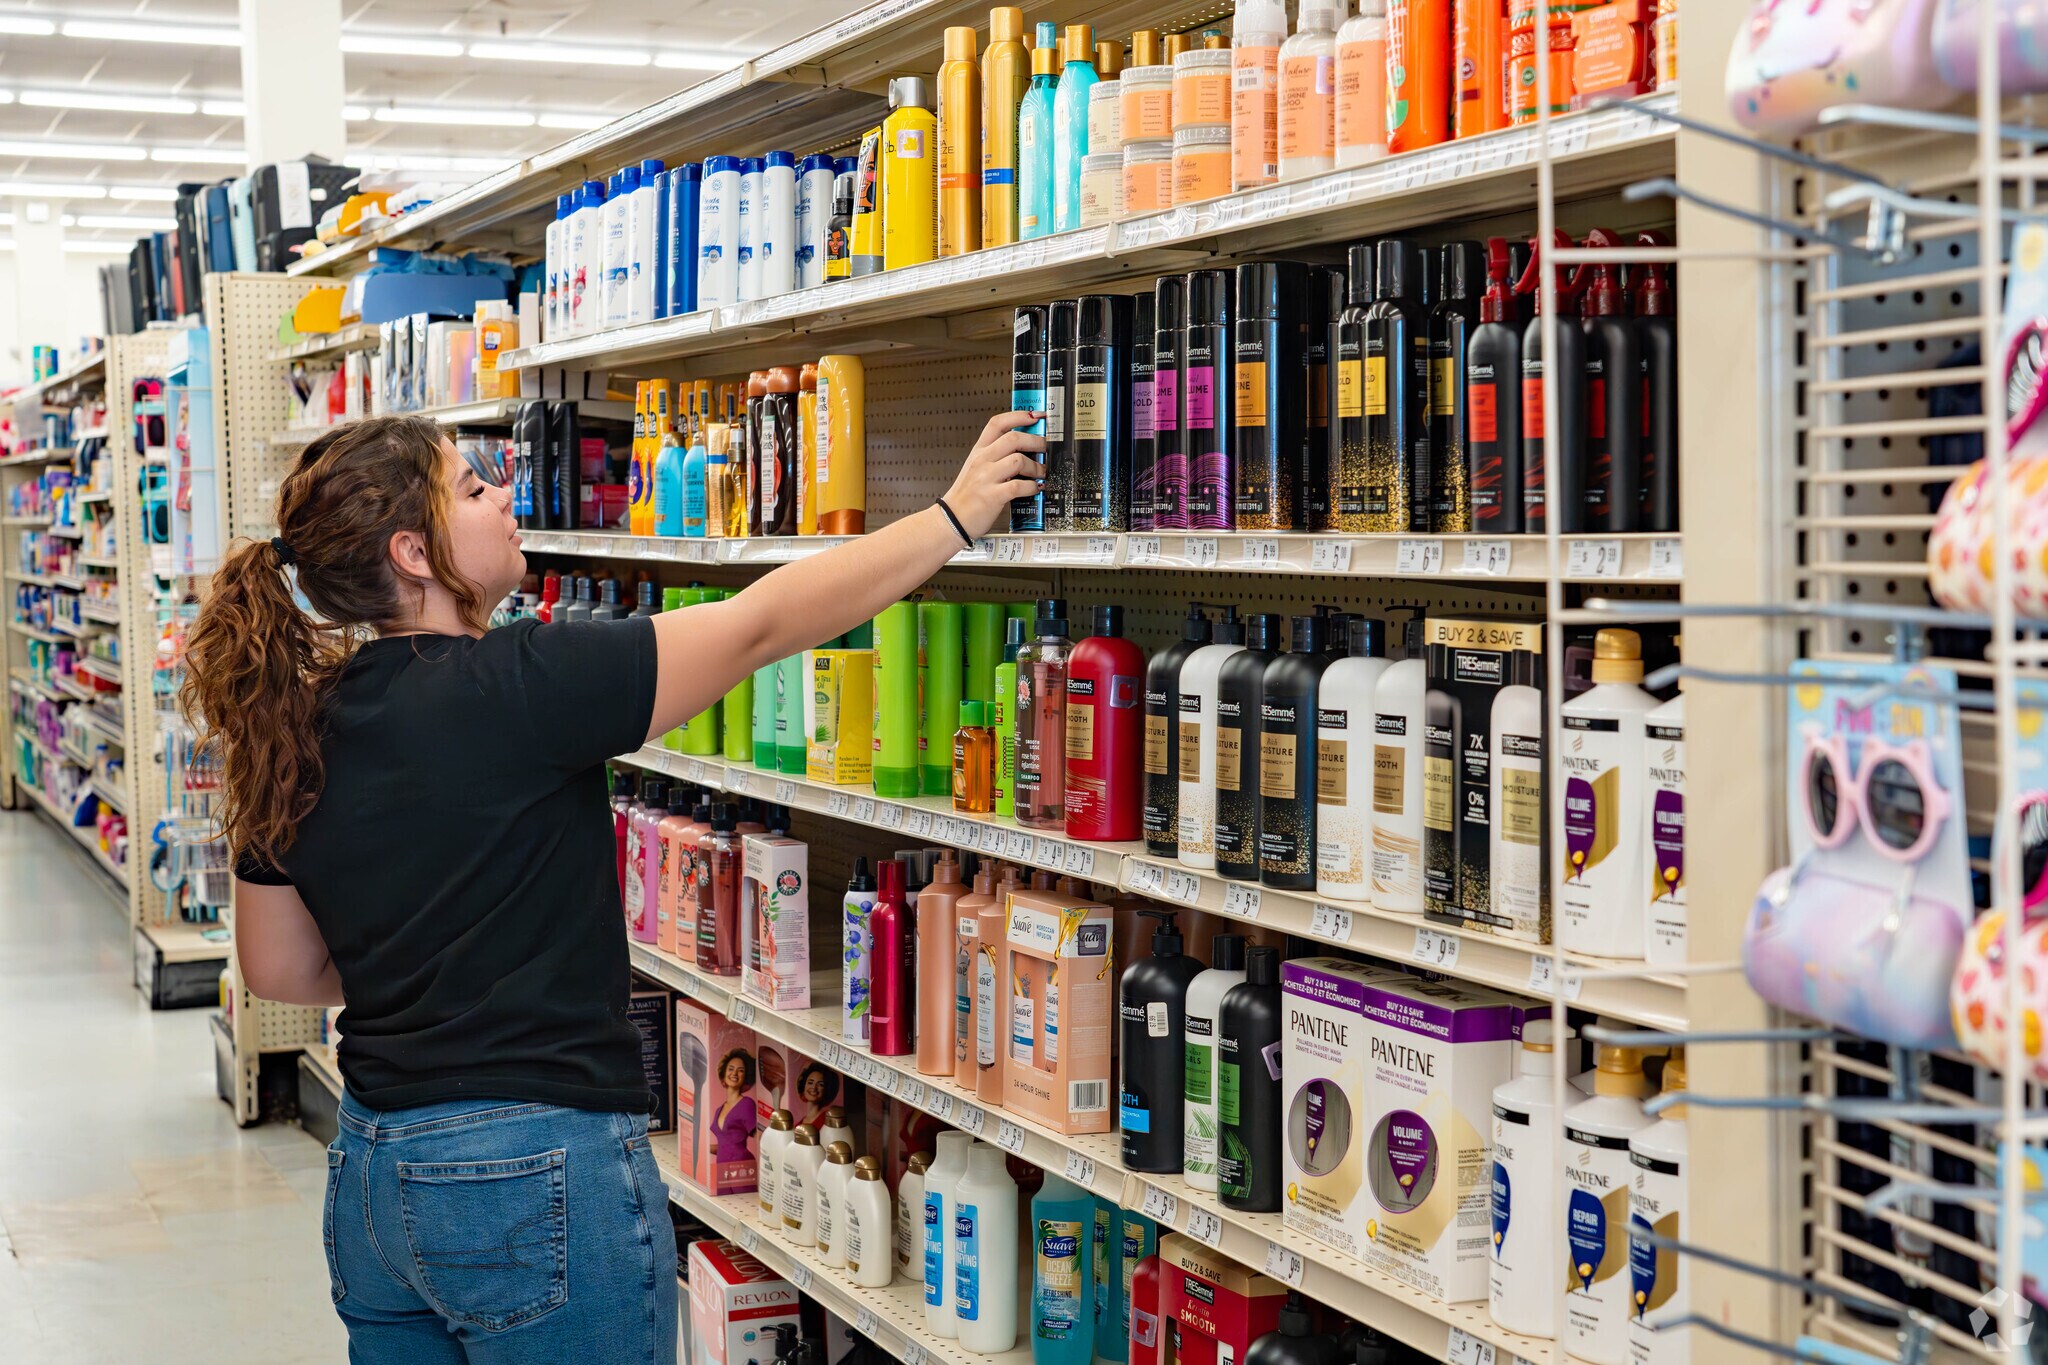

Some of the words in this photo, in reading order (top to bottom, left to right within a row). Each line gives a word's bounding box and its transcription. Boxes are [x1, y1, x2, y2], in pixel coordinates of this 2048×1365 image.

[1025, 121, 1032, 141] it
[1186, 346, 1211, 357] Semmé
[1235, 340, 1263, 352] Semmé
[1077, 363, 1105, 374] ESemmé
[1156, 387, 1173, 397] UME
[1208, 544, 1214, 555] 99
[1270, 545, 1276, 557] 99
[1332, 546, 1340, 569] 5
[1422, 546, 1430, 570] 6
[1432, 547, 1439, 560] 99
[1488, 546, 1497, 572] 6
[1596, 547, 1606, 574] 2
[1438, 626, 1464, 642] BUY
[1467, 628, 1474, 642] 2
[1476, 629, 1487, 644] &
[1489, 630, 1524, 646] SAVE
[816, 658, 828, 667] VIA
[1457, 656, 1500, 673] TRESemmé
[1470, 734, 1484, 750] 7X
[1030, 753, 1040, 761] hips
[1320, 754, 1345, 763] STURE
[1468, 791, 1484, 806] 0%
[1566, 797, 1592, 812] VOLUME
[1261, 832, 1282, 842] SHAMPOO
[1080, 851, 1086, 872] 7
[1183, 878, 1192, 899] 7
[1243, 892, 1251, 914] 5
[1252, 895, 1258, 906] 99
[1012, 916, 1032, 934] Suave
[1036, 924, 1055, 935] MOROCCAN
[1332, 913, 1341, 937] 5
[1342, 916, 1349, 929] 99
[1036, 930, 1052, 942] INFUSION
[1437, 938, 1446, 963] 9
[1448, 941, 1456, 955] 99
[1304, 976, 1316, 985] BUY
[1315, 978, 1320, 986] 2
[1324, 981, 1338, 992] SAVE
[1284, 980, 1314, 996] ACHETEZ-EN
[1313, 988, 1318, 997] 2
[1319, 989, 1324, 998] ET
[1326, 990, 1360, 1008] ÉCONOMISEZ
[636, 1000, 661, 1008] WATTS
[1014, 1004, 1032, 1018] Suave
[1386, 1000, 1399, 1011] BUY
[1399, 1005, 1404, 1013] 2
[1408, 1007, 1424, 1019] SAVE
[1291, 1010, 1348, 1048] PANTENE
[1364, 1004, 1397, 1022] ACHETEZ-EN
[1397, 1014, 1402, 1022] 2
[1402, 1014, 1409, 1025] ET
[1410, 1016, 1449, 1036] ÉCONOMISEZ
[1296, 1038, 1314, 1049] FULLNESS
[1318, 1044, 1330, 1053] EVERY
[1330, 1048, 1342, 1056] WASH
[1313, 1050, 1328, 1060] CHAQUE
[1328, 1054, 1343, 1064] LAVAGE
[1371, 1036, 1435, 1078] PANTENE
[1376, 1066, 1394, 1078] FULLNESS
[1399, 1074, 1413, 1084] EVERY
[1414, 1078, 1427, 1087] WASH
[1020, 1081, 1035, 1093] HOUR
[1035, 1087, 1050, 1101] SHINE
[1394, 1079, 1411, 1091] CHAQUE
[1411, 1086, 1428, 1096] LAVAGE
[1010, 1128, 1017, 1146] 5
[1392, 1124, 1423, 1141] VOLUME
[1080, 1160, 1087, 1180] 6
[1565, 1166, 1610, 1188] PANTENE
[1160, 1196, 1168, 1217] 5
[1316, 1200, 1341, 1216] CONDITIONER
[1320, 1209, 1344, 1224] REVITALISANT
[1572, 1208, 1599, 1228] REPAIR
[1205, 1216, 1212, 1238] 5
[1044, 1240, 1075, 1251] Suave
[1398, 1238, 1426, 1255] CONDITIONER
[1401, 1248, 1430, 1265] REVITALISANT
[1046, 1260, 1072, 1273] OCEAN
[1181, 1258, 1194, 1272] BUY
[1194, 1262, 1199, 1272] 2
[1199, 1266, 1204, 1275] &
[1204, 1268, 1221, 1283] SAVE
[1288, 1256, 1295, 1279] 9
[1044, 1273, 1073, 1286] BREEZE
[1185, 1277, 1214, 1299] TRESemmé
[734, 1290, 792, 1307] REVLON
[1043, 1288, 1073, 1299] REFRESHING
[1187, 1300, 1210, 1318] Keratin
[1180, 1308, 1216, 1335] SMOOTH
[1476, 1342, 1483, 1365] 7
